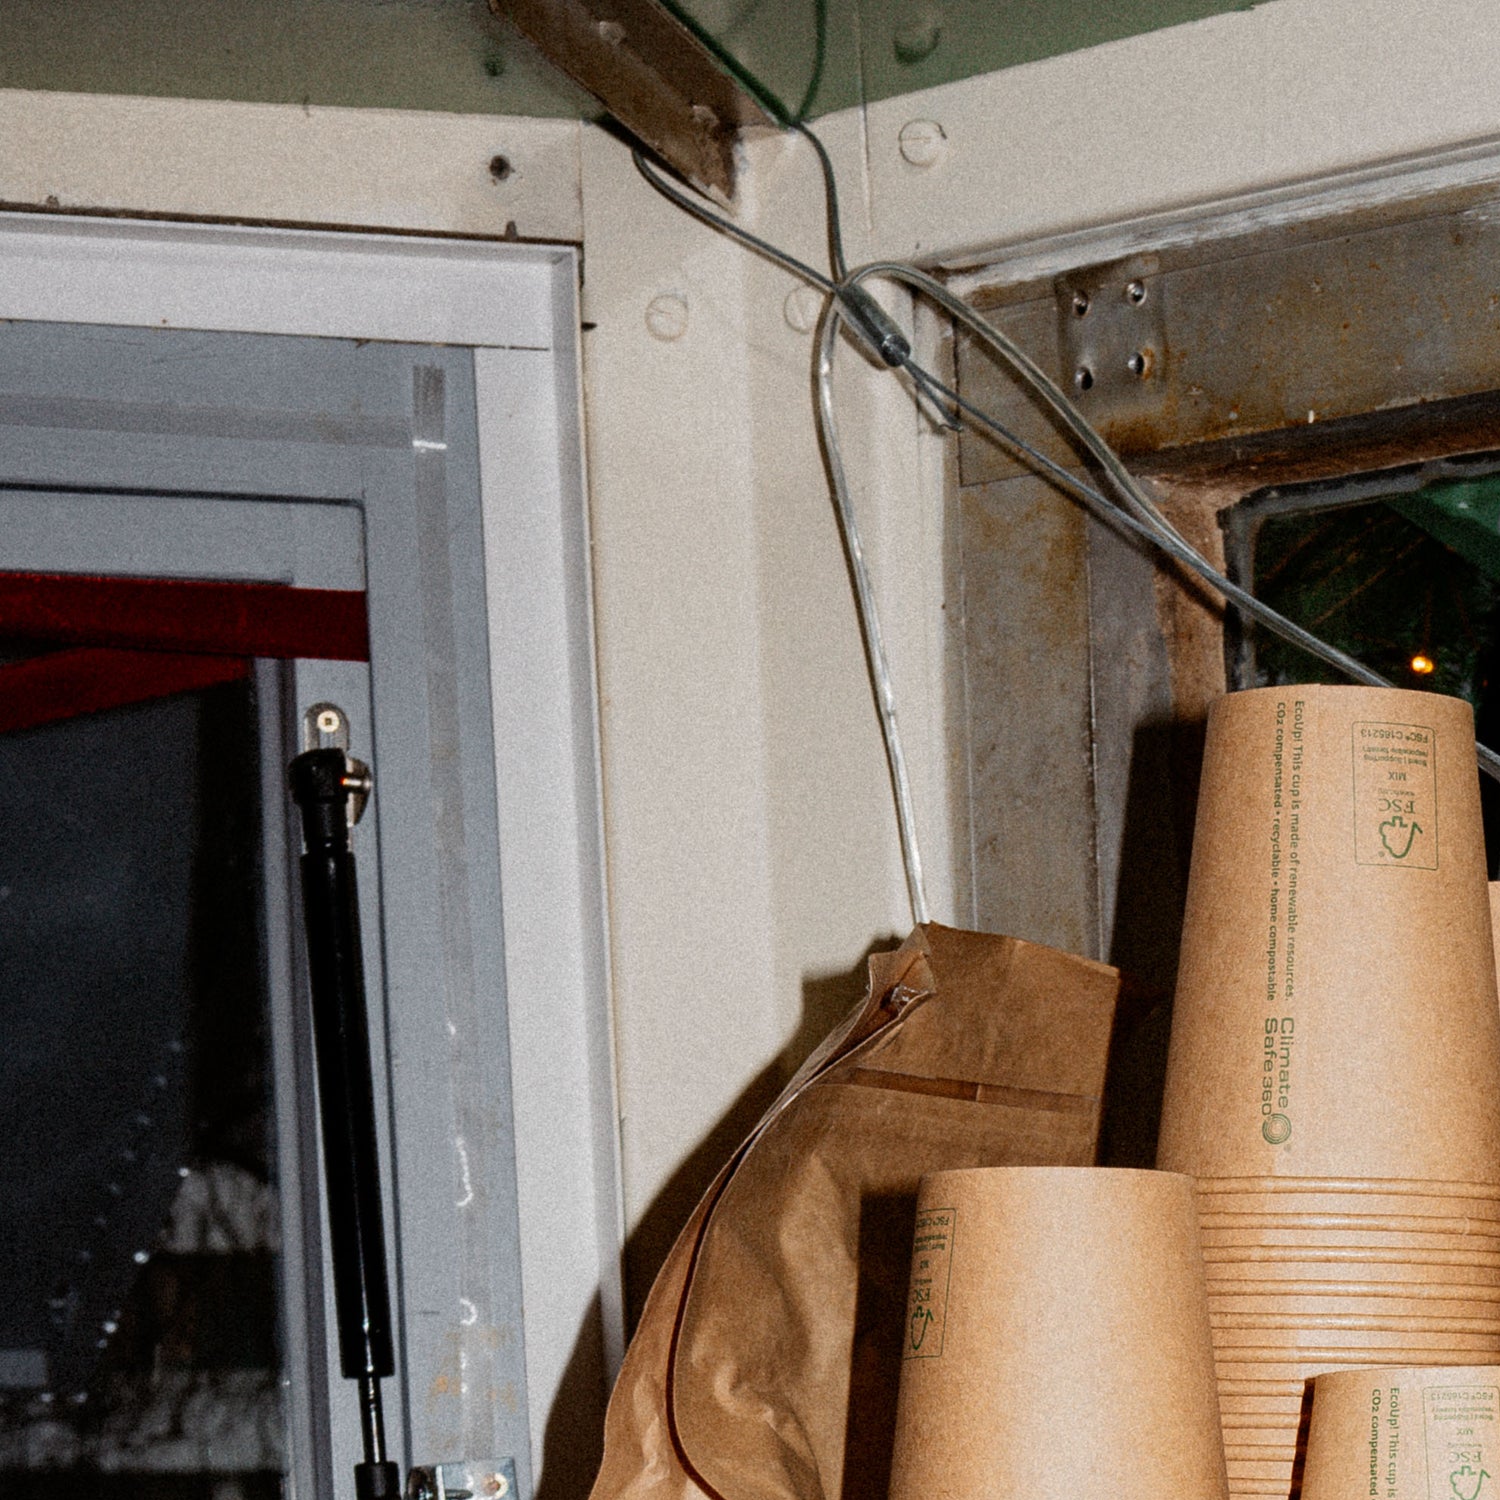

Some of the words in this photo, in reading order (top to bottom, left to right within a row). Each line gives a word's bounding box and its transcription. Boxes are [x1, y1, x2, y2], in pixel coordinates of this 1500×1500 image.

[1291, 701, 1305, 741] EcoUp!
[1273, 729, 1285, 808] compensated
[1292, 746, 1303, 770] This
[1290, 775, 1301, 796] cup
[1388, 771, 1406, 781] MIX
[1291, 800, 1303, 809] is
[1378, 798, 1415, 814] FSC
[1270, 818, 1282, 877] recyclable
[1291, 814, 1300, 848] made
[1290, 852, 1300, 865] of
[1270, 889, 1280, 922] home
[1287, 868, 1298, 933] renewable
[1267, 926, 1278, 1001] compostable
[1285, 937, 1295, 1001] resources.
[1264, 1018, 1278, 1072] Safe
[1278, 1018, 1294, 1108] Climate
[1386, 1388, 1400, 1429] EcoUp!
[1369, 1416, 1380, 1496] compensated
[1389, 1433, 1399, 1458] This
[1448, 1451, 1481, 1463] FSC
[1386, 1462, 1397, 1485] cup
[1388, 1488, 1398, 1497] is
